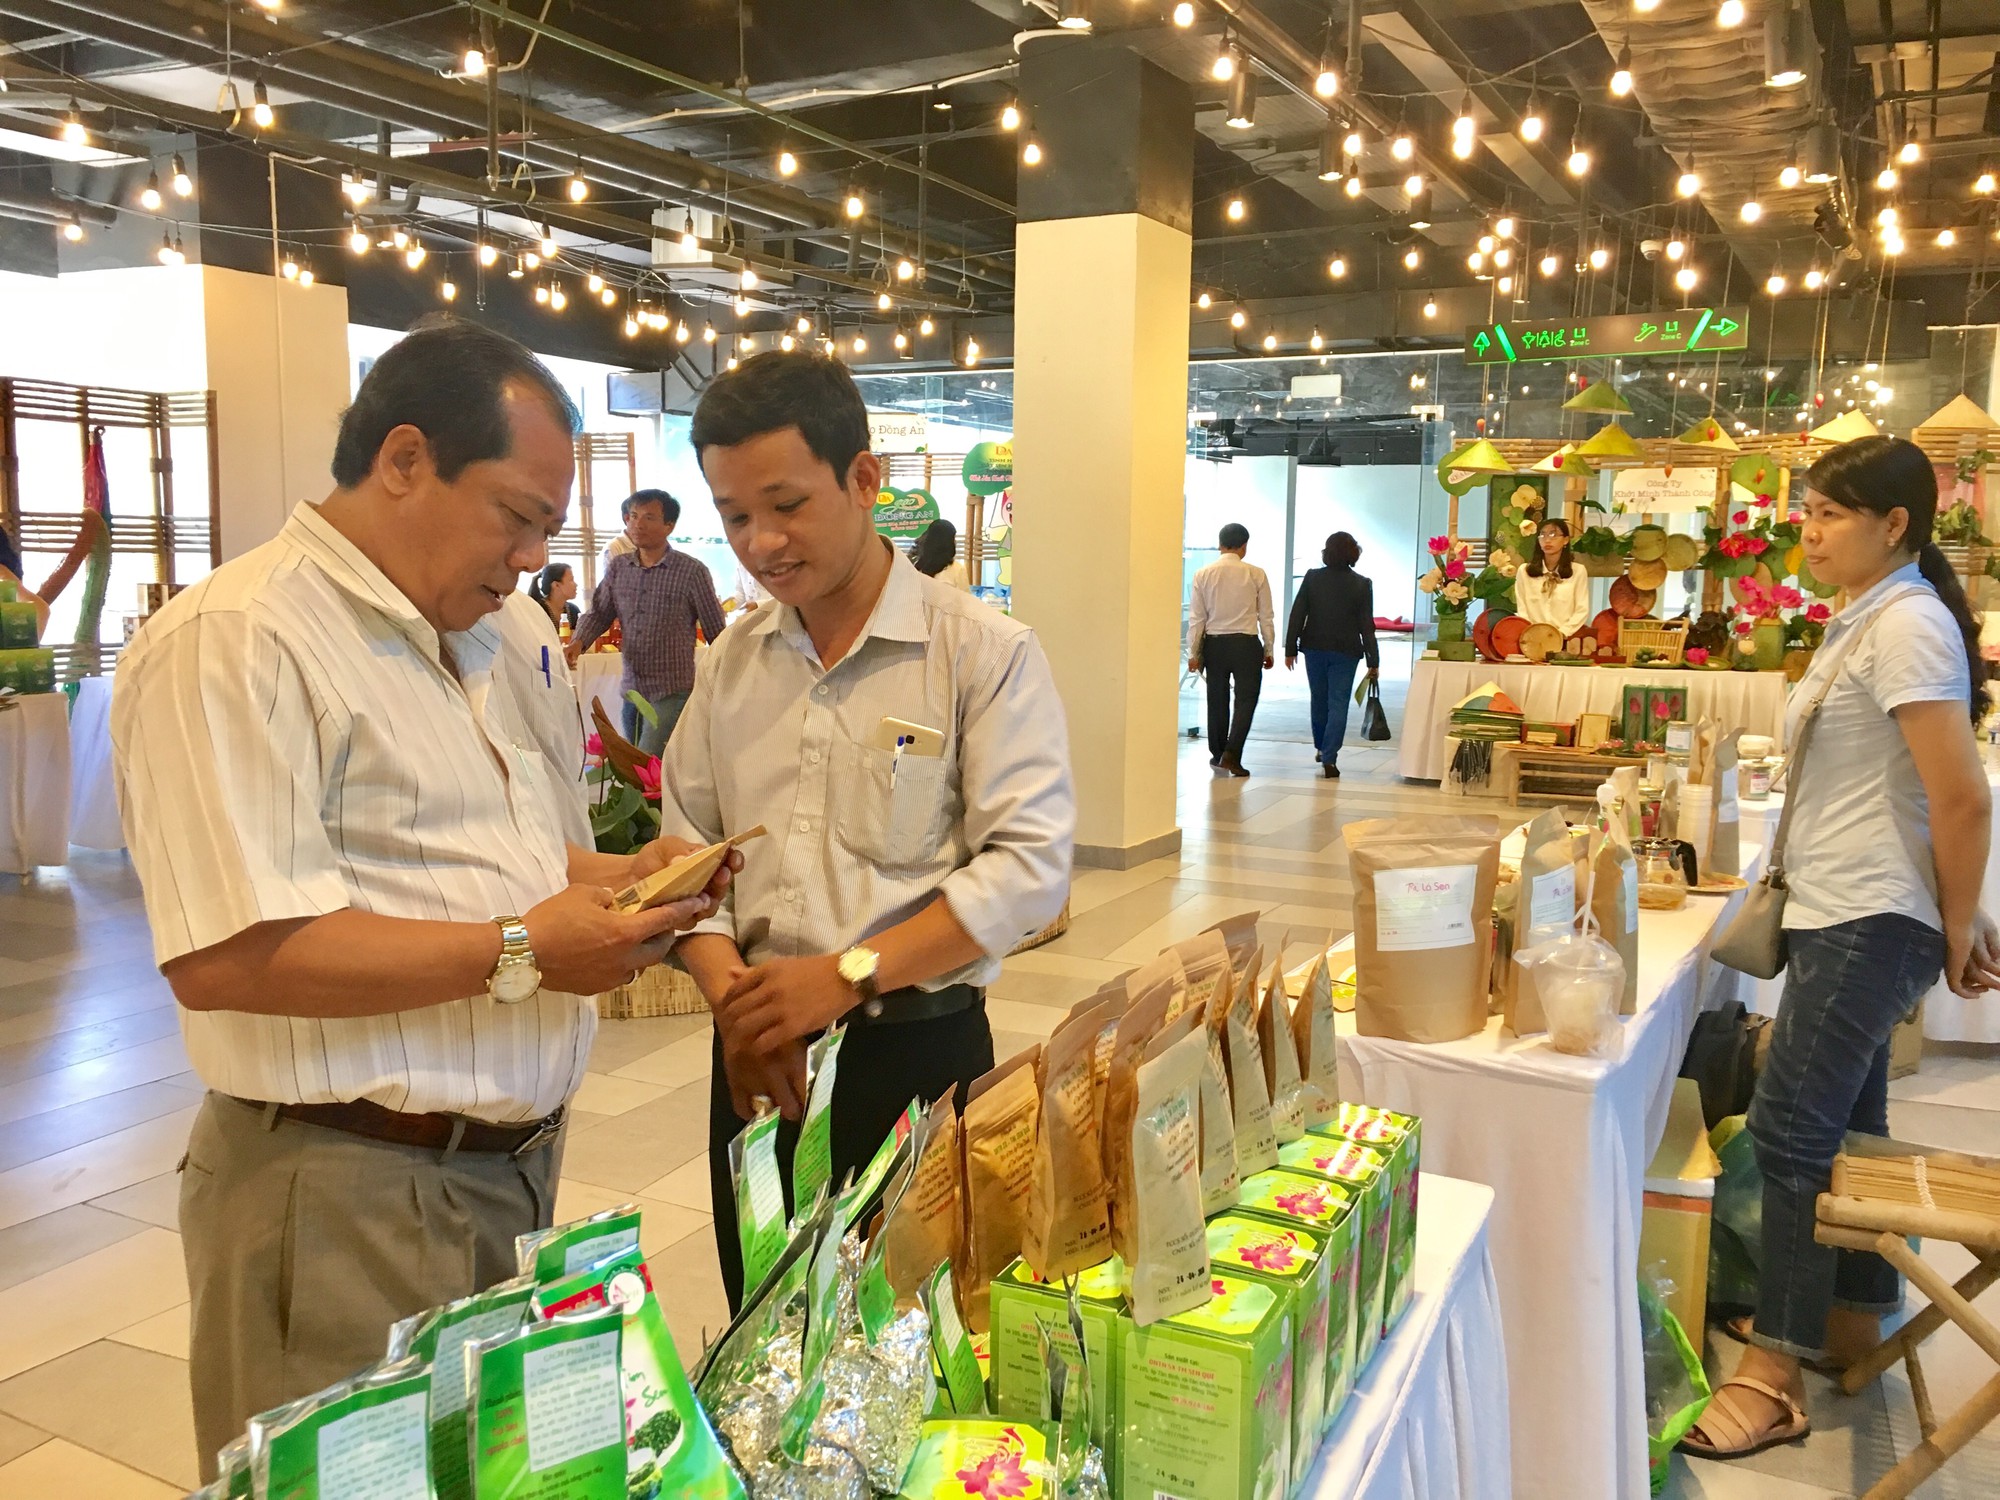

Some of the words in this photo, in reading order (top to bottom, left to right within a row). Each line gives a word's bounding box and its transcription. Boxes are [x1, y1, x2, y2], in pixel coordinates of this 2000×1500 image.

[1665, 321, 1679, 332] L1
[1574, 327, 1586, 339] L1
[909, 425, 925, 435] An
[1434, 882, 1450, 891] Sen
